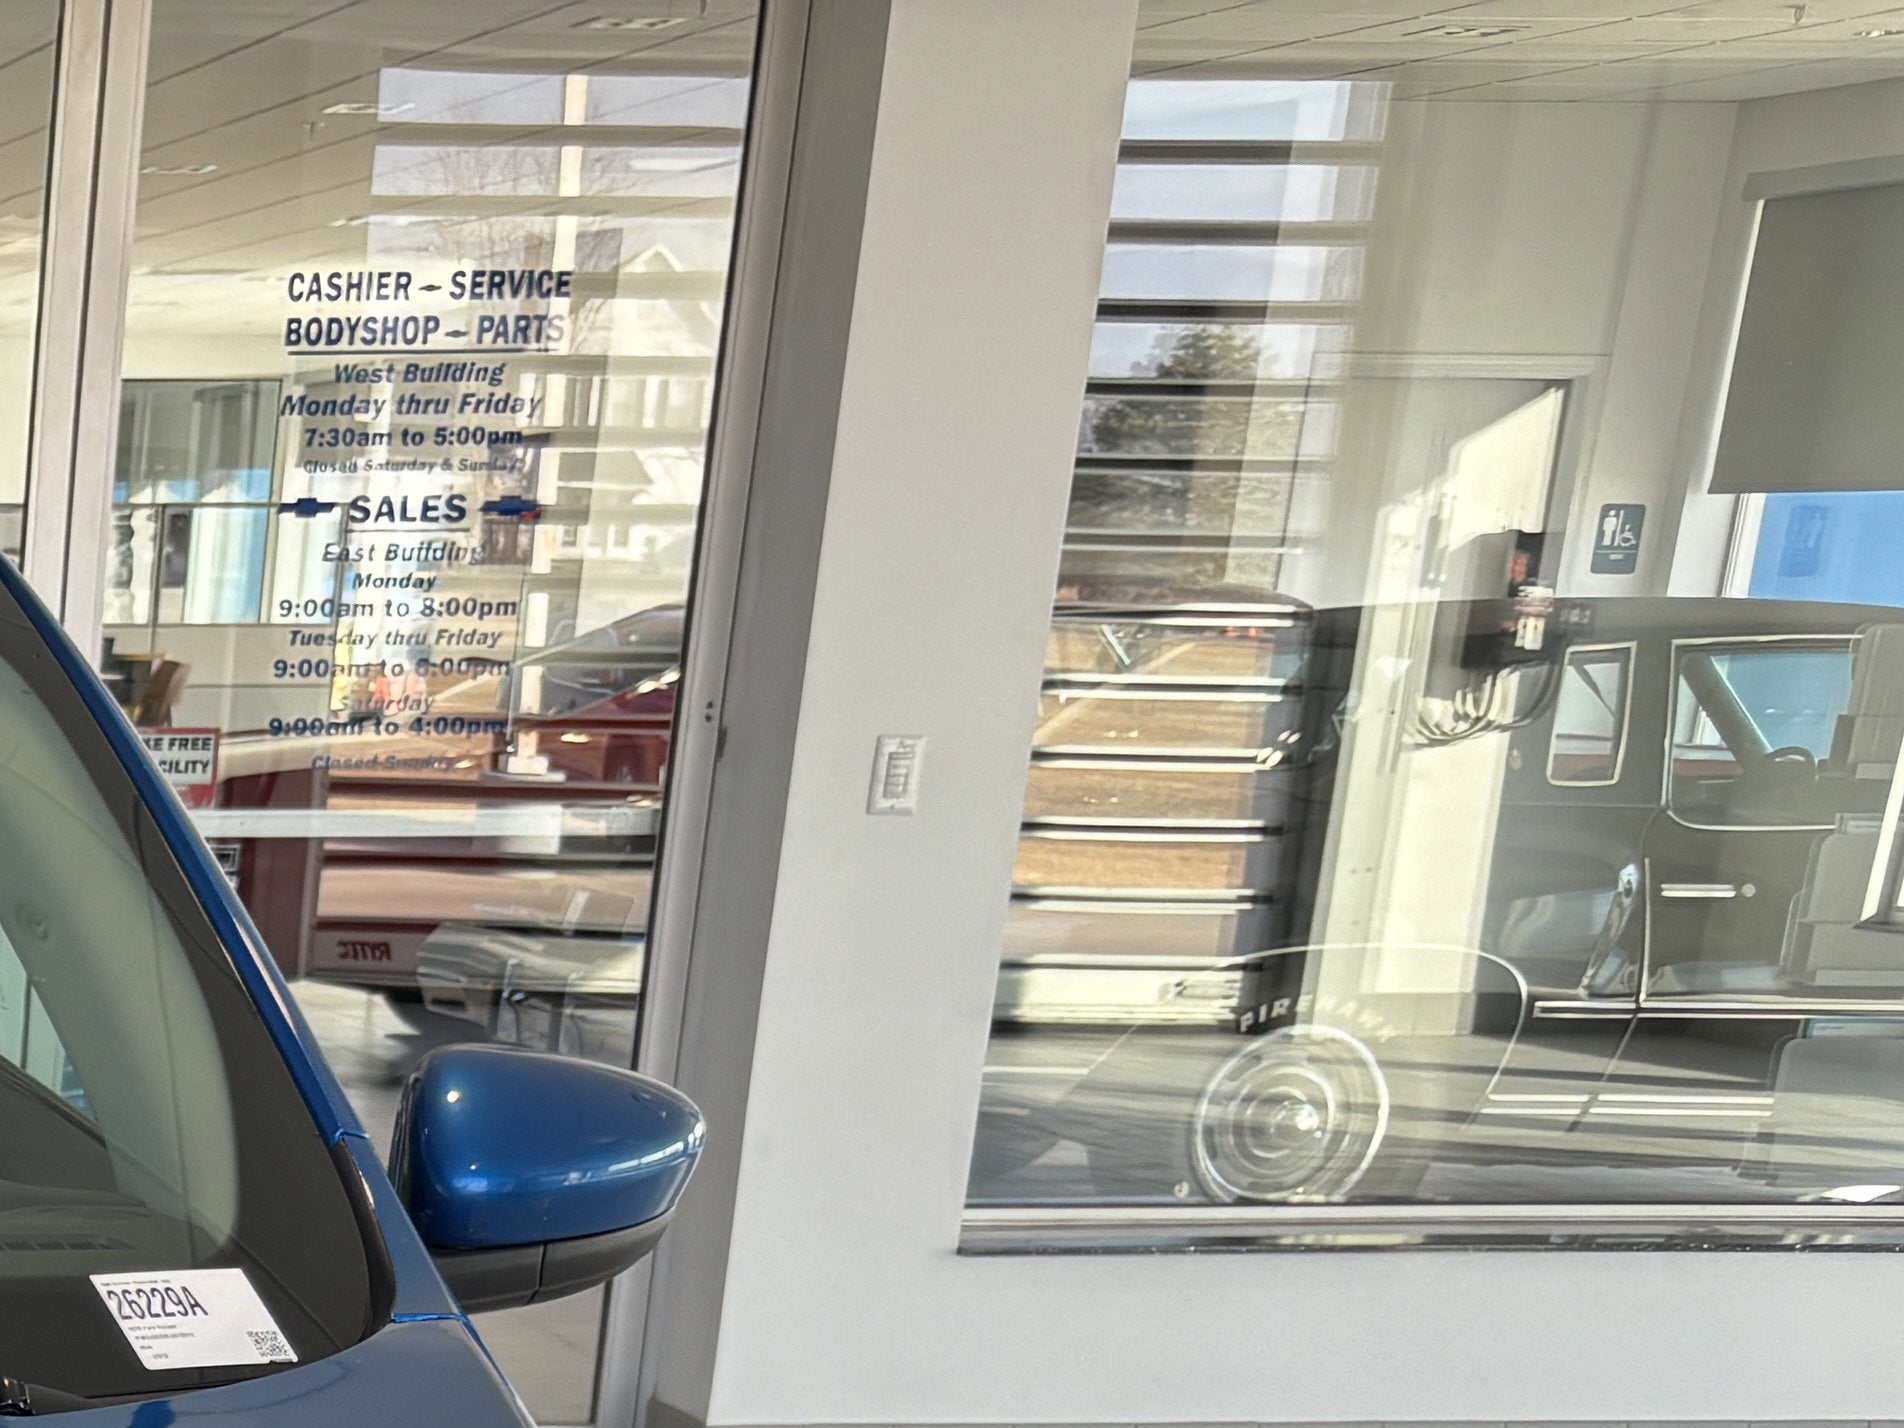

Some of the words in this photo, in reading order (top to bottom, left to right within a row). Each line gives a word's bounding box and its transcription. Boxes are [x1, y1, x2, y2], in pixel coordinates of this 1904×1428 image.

[287, 271, 412, 302] CASHIER
[449, 269, 573, 300] SERVICE
[284, 315, 441, 347] BODYSHOP
[476, 314, 566, 344] PARTS
[334, 362, 396, 384] West
[403, 361, 507, 387] Building
[280, 394, 387, 420] Monday
[395, 393, 449, 415] thru
[457, 392, 544, 419] Friday
[304, 427, 391, 448] 7:30am
[401, 427, 425, 447] to
[433, 425, 523, 450] 5:00pm
[303, 459, 358, 474] Closed
[363, 458, 436, 475] Saturday
[349, 493, 468, 524] SALES
[322, 542, 375, 563] East
[384, 540, 486, 566] Building
[352, 572, 439, 591] Monday
[278, 599, 374, 618] 9:00am
[385, 598, 410, 617] to
[420, 597, 518, 620] 8:00pm
[289, 630, 378, 649] Tuesday
[385, 629, 428, 646] thru
[434, 628, 504, 648] Friday
[273, 658, 373, 679] 9:00am
[378, 658, 405, 678] to
[374, 716, 399, 737] to
[167, 736, 213, 751] FREE
[106, 1286, 209, 1321] 26229A
